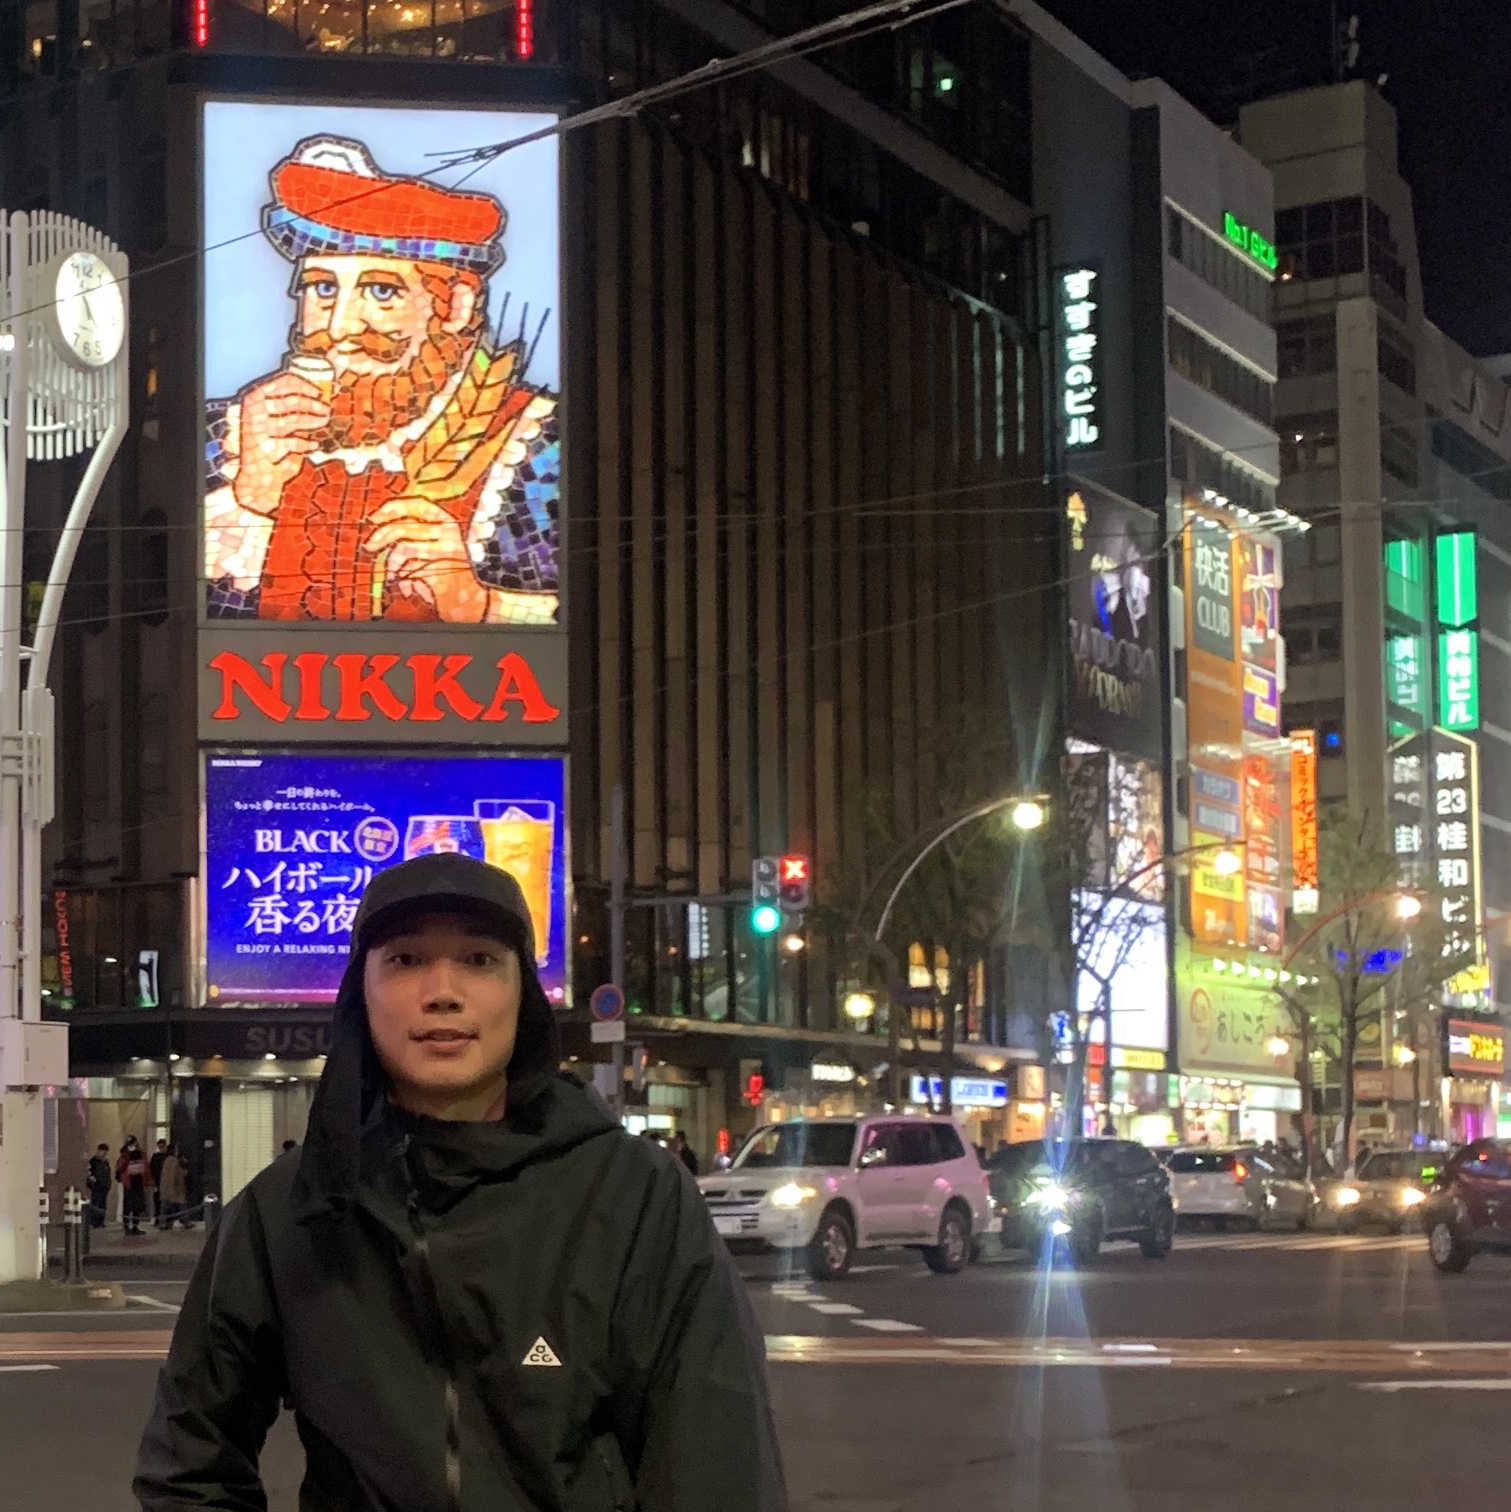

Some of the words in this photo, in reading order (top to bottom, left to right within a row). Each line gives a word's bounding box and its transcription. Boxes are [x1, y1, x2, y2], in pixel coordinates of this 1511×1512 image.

[1064, 269, 1099, 446] すすきのビル
[1195, 539, 1231, 597] 快活
[1197, 595, 1232, 639] CLUB
[209, 651, 560, 723] NIKKA
[254, 829, 352, 853] BLACK
[244, 893, 361, 935] 香る夜
[236, 944, 270, 954] ENJOY
[273, 944, 281, 954] A
[284, 944, 335, 954] RELAXING
